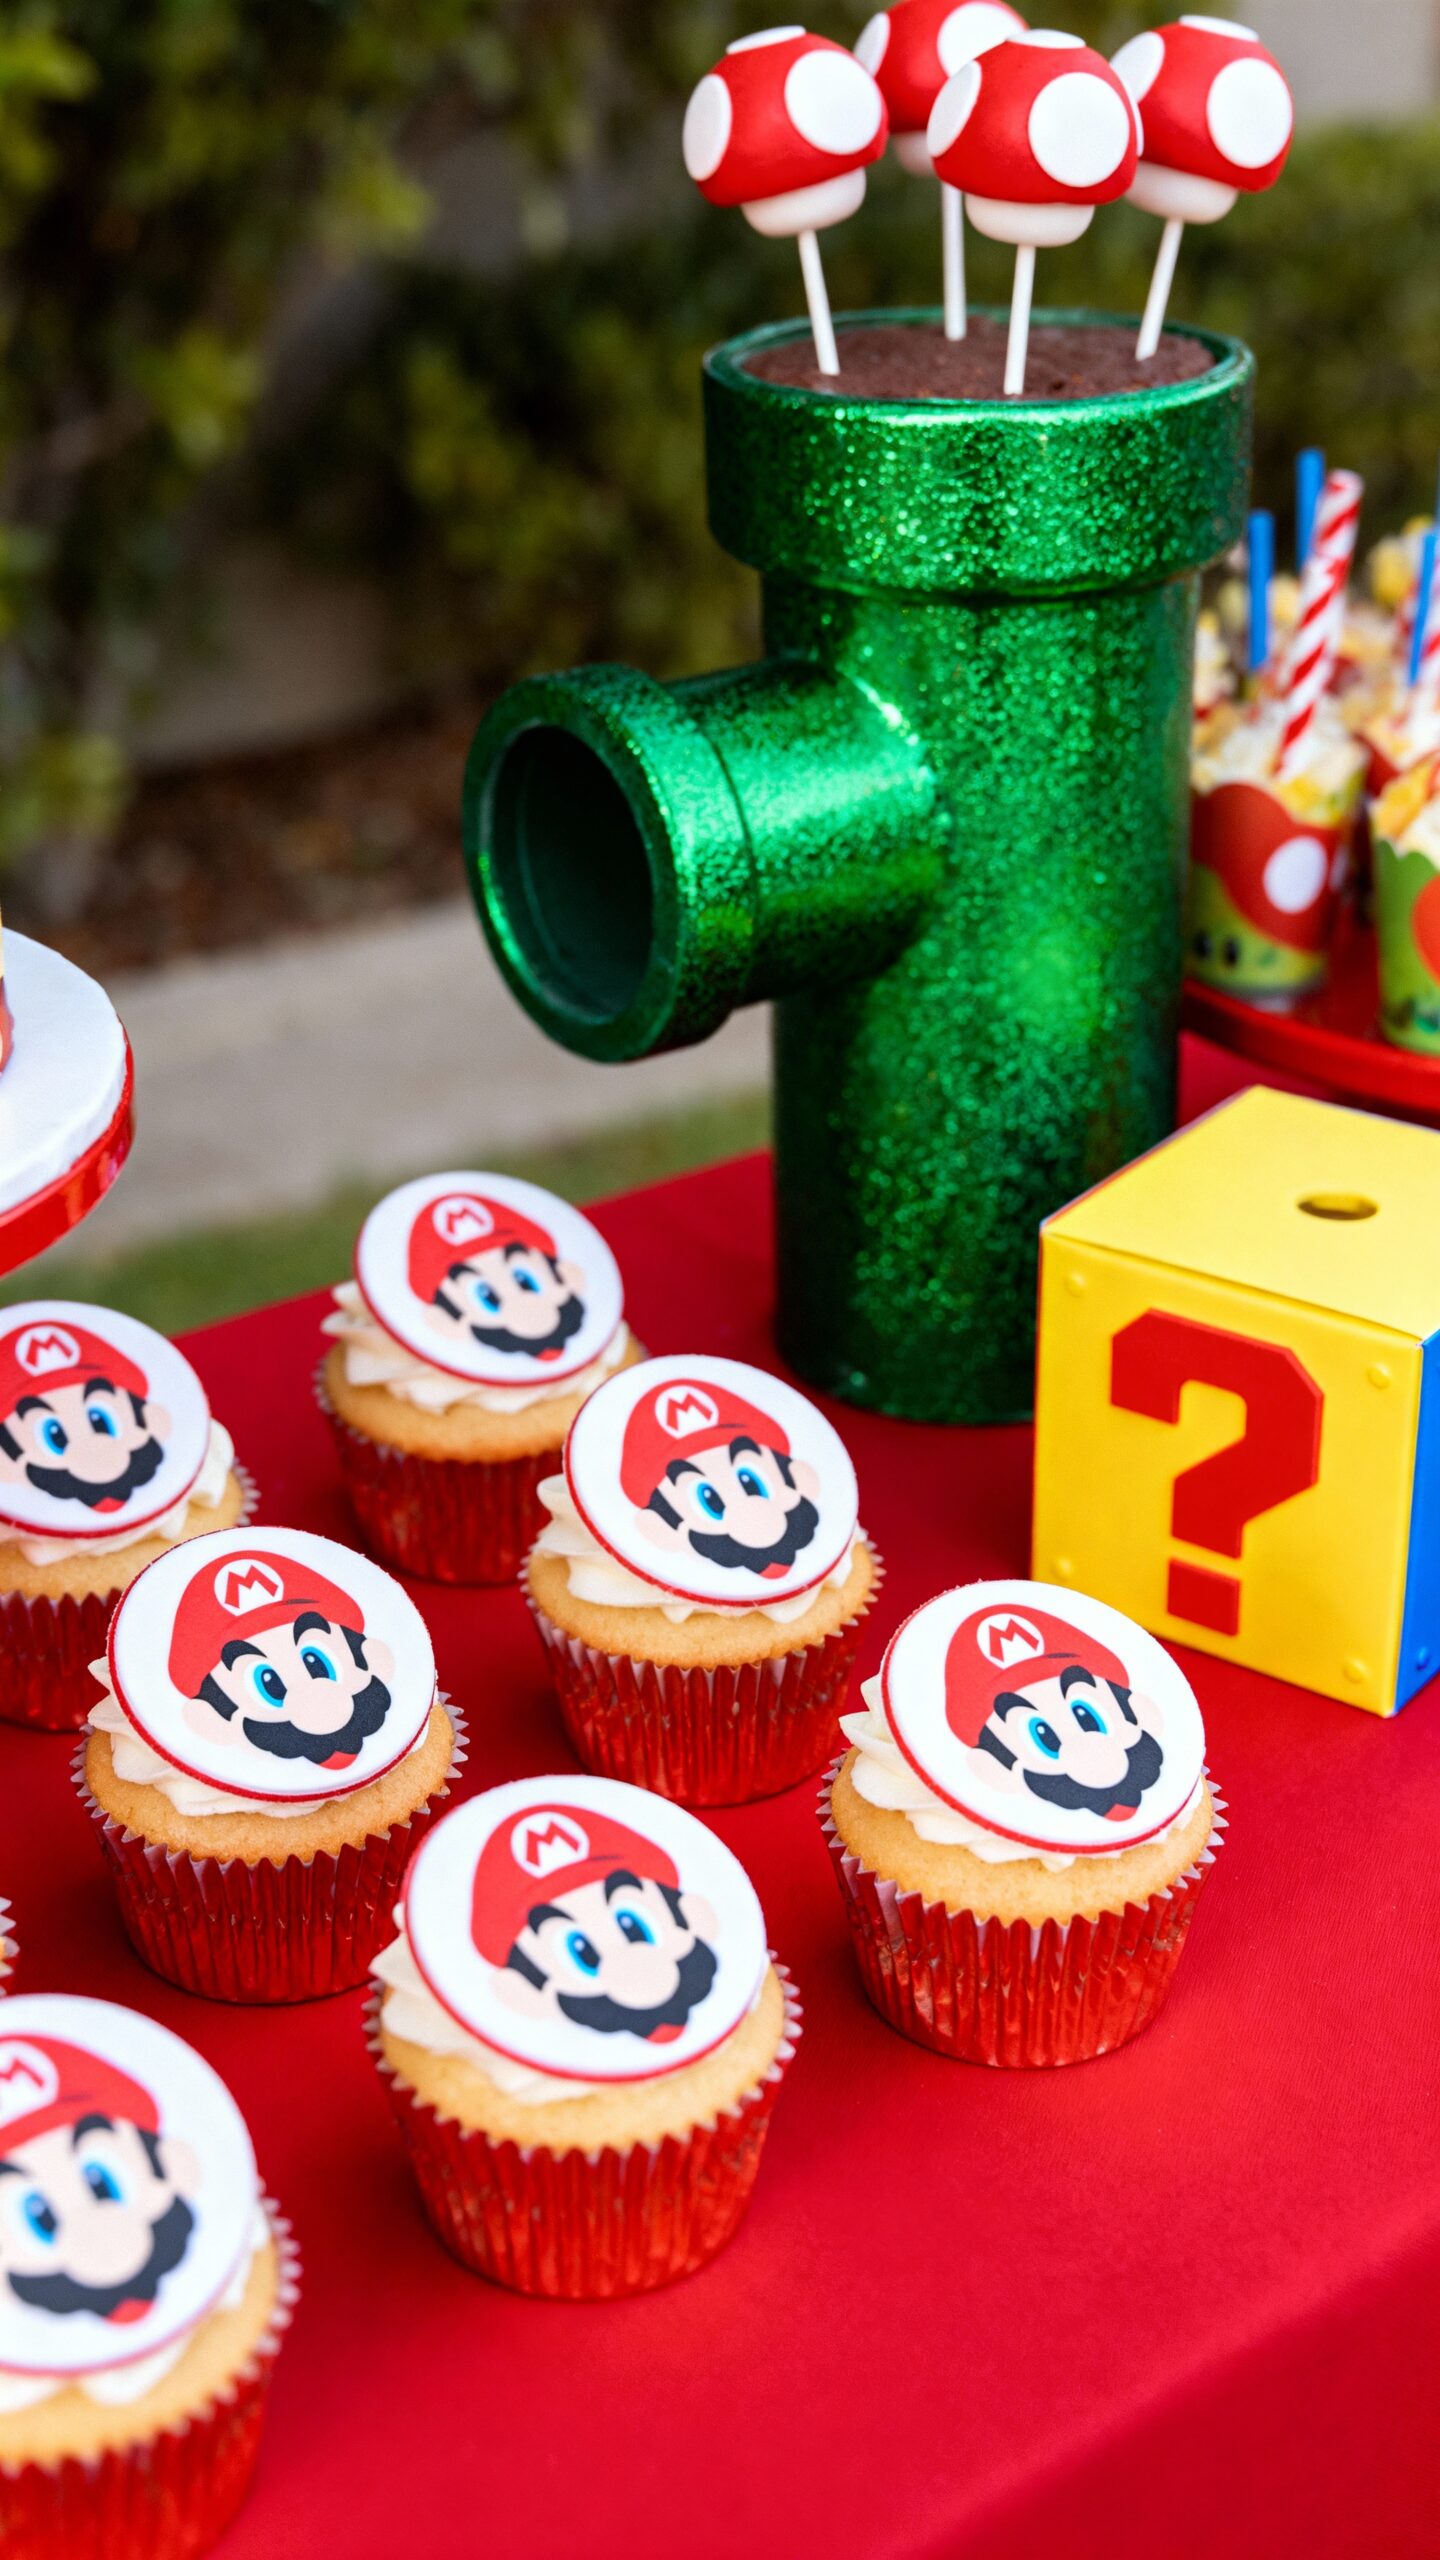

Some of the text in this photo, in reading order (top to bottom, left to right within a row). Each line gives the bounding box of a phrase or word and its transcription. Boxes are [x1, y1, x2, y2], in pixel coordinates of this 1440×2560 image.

[446, 1206, 485, 1236] M
[25, 1333, 73, 1368] M
[666, 1393, 713, 1431] M
[1110, 1310, 1324, 1637] ?
[224, 1565, 279, 1609] M
[988, 1618, 1040, 1662] M
[525, 1820, 580, 1867] M
